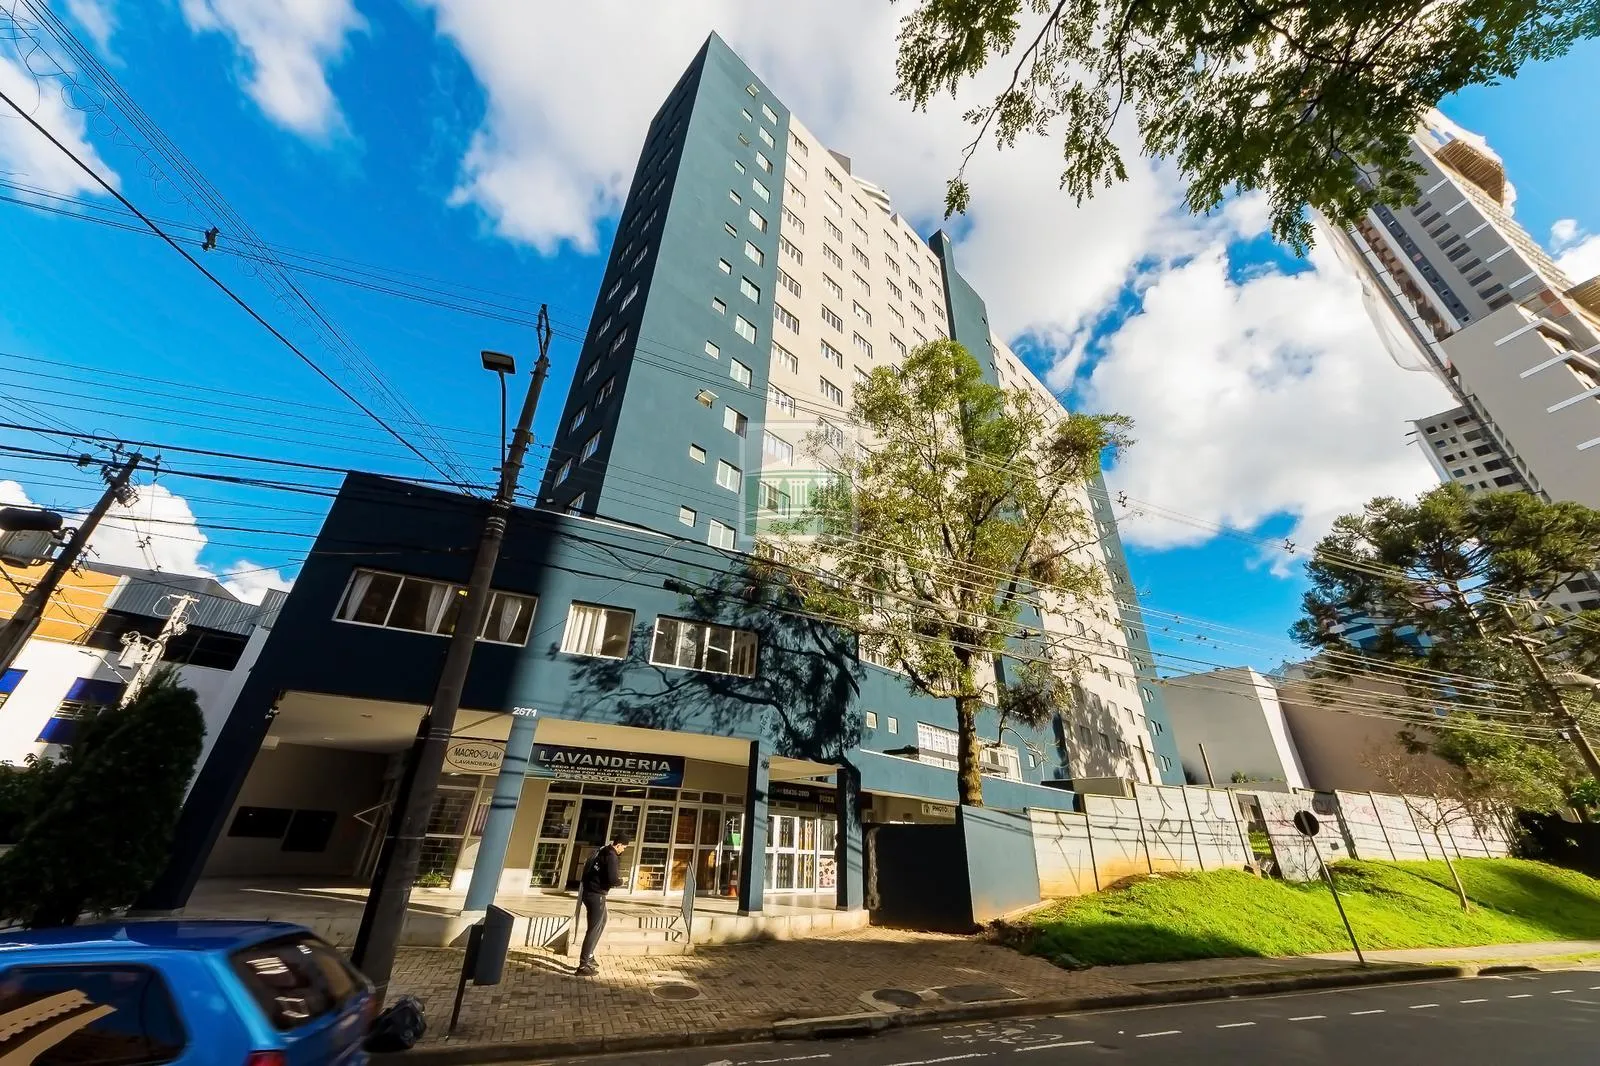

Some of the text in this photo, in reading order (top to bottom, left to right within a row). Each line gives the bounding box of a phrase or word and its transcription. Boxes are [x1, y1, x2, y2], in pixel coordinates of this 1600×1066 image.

[512, 706, 537, 717] 2671
[455, 759, 497, 768] LAVANDERIAS
[539, 750, 671, 772] LAVANDERIA
